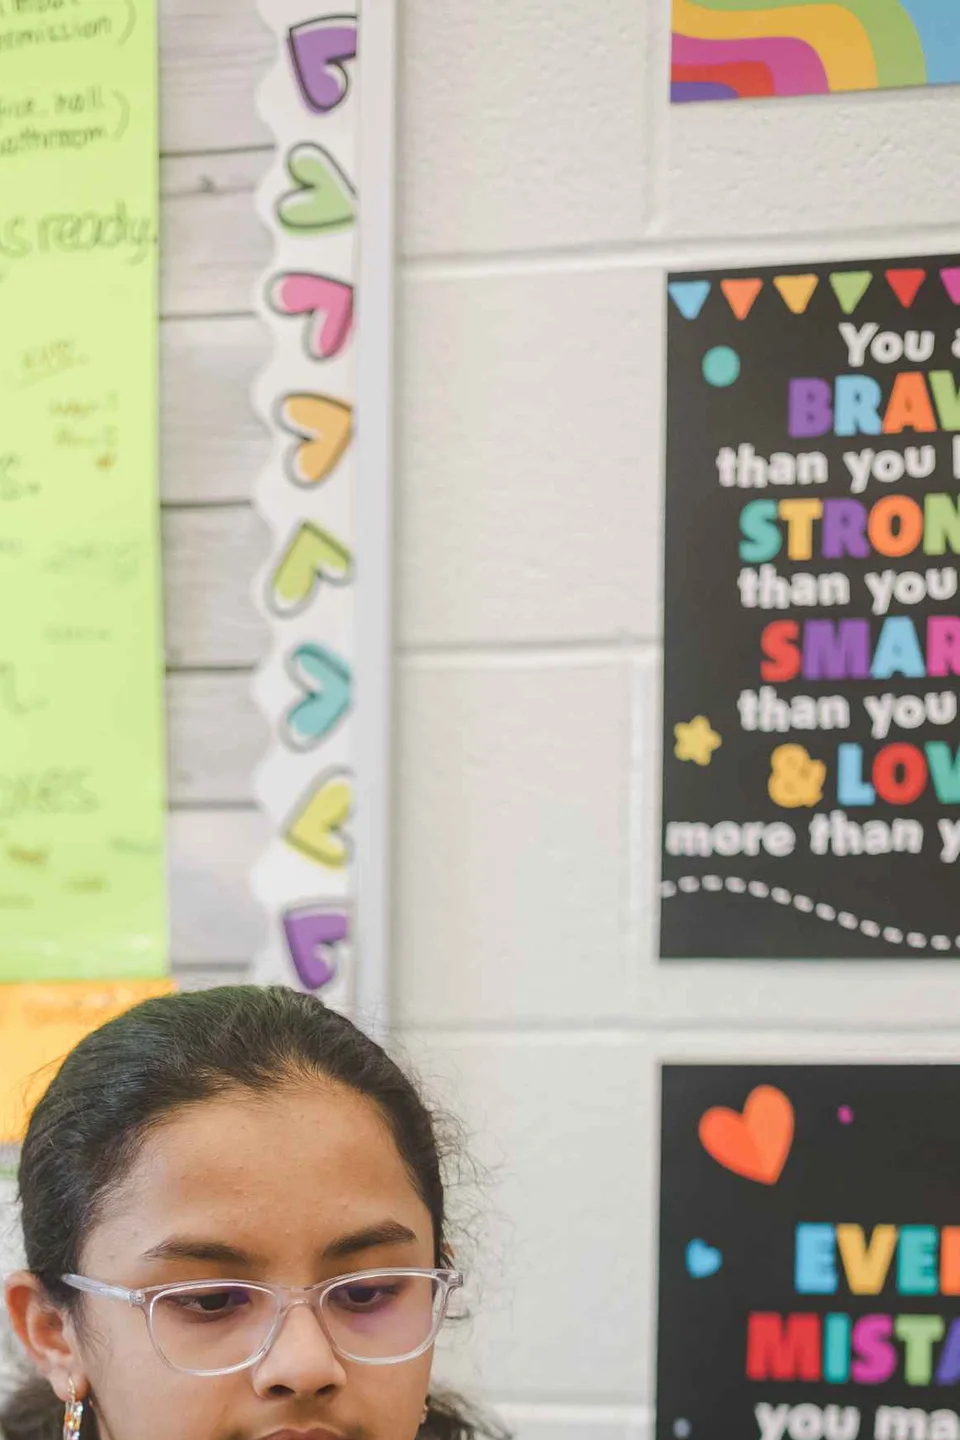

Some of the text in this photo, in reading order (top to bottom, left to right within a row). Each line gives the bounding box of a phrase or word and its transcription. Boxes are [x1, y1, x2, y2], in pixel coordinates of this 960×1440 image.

[838, 322, 935, 368] You
[716, 442, 829, 487] than
[842, 445, 936, 493] you
[738, 564, 958, 615] than you
[738, 687, 957, 739] than you
[767, 743, 826, 808] &
[664, 820, 797, 857] more
[809, 811, 924, 857] than
